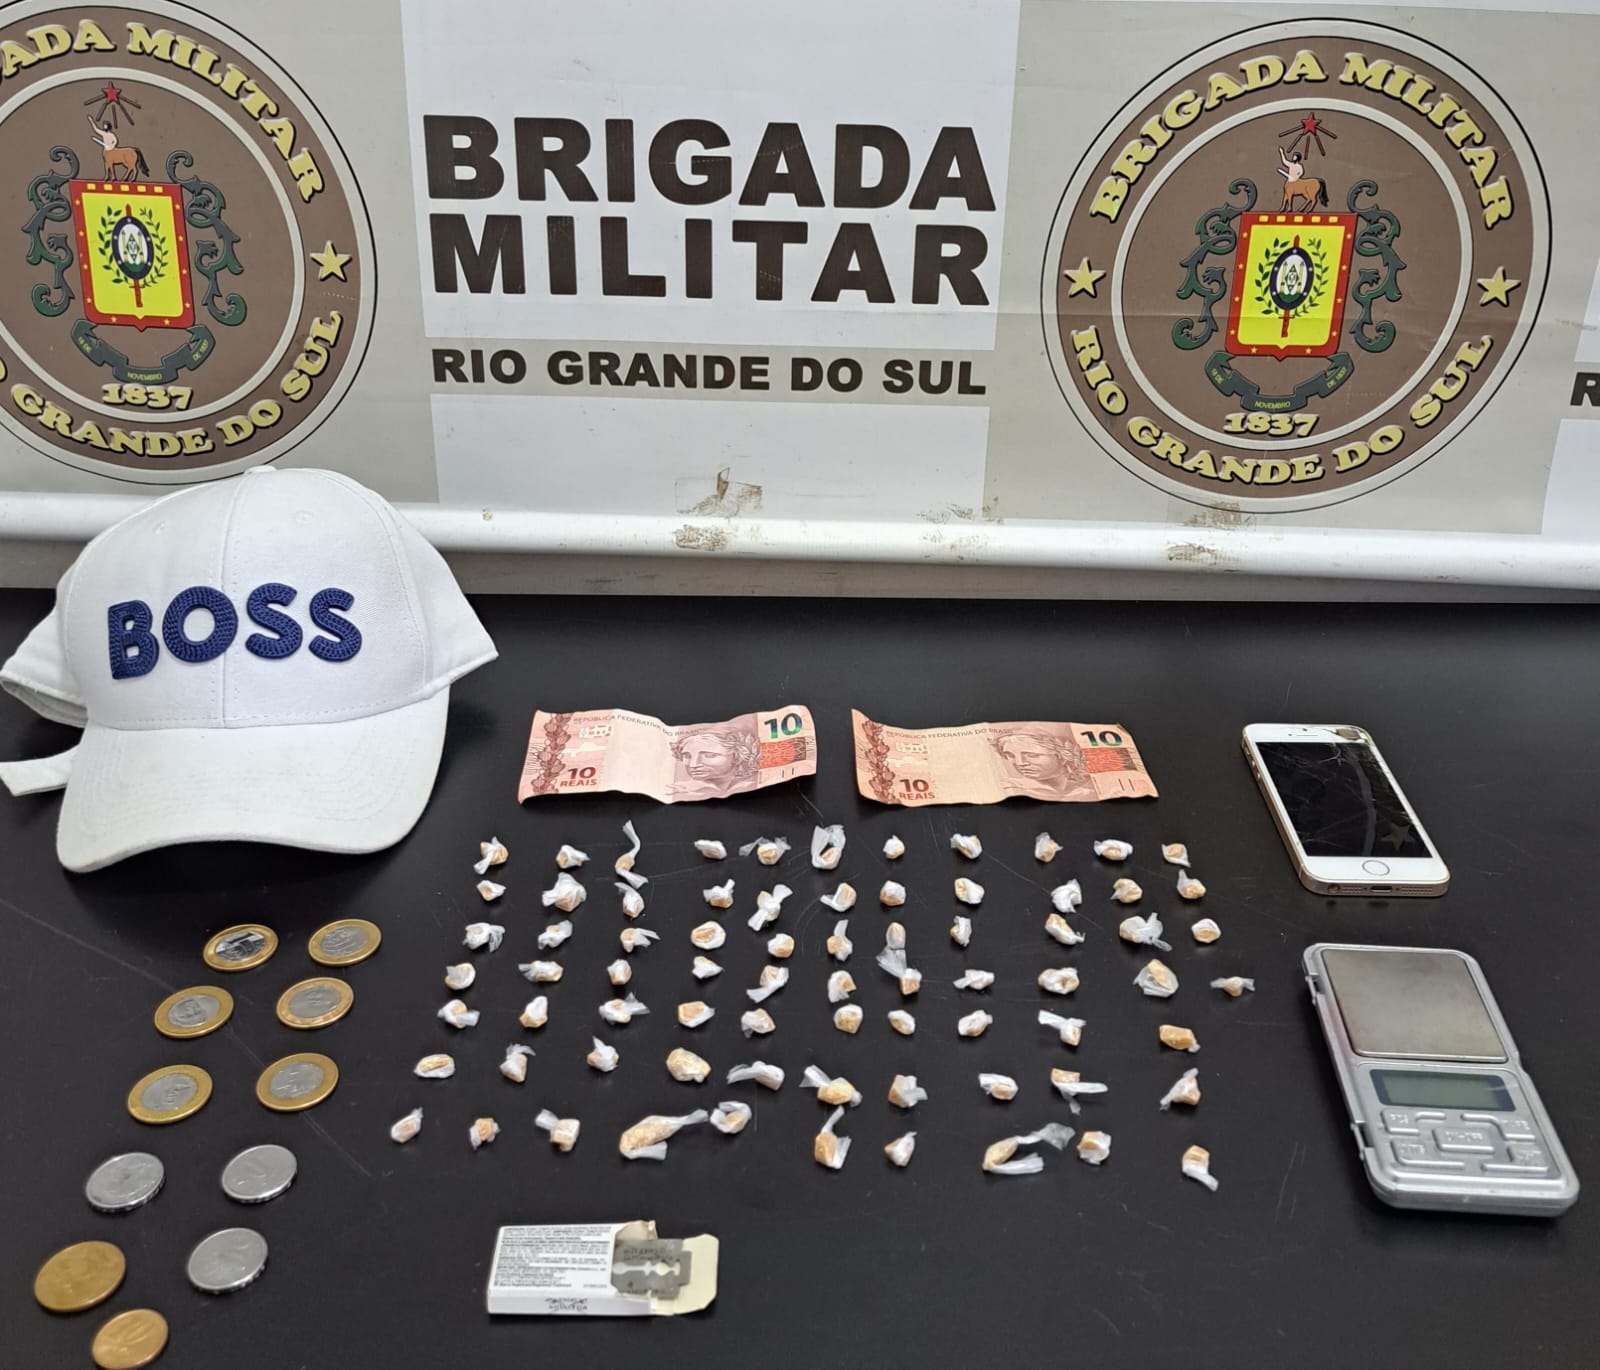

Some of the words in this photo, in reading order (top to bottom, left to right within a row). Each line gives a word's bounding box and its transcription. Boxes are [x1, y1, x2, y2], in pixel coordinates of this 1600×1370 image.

[0, 19, 116, 79] ADA
[127, 22, 326, 203] MILITAR
[1090, 49, 1328, 223] BRIGADA
[1339, 53, 1514, 230] MILITAR
[423, 114, 997, 212] BRIGADA
[429, 212, 990, 306] MILITAR
[11, 383, 215, 458] GRANDE
[217, 399, 283, 447] DO
[280, 310, 343, 403] SUL
[431, 347, 528, 385] RIO
[546, 349, 771, 390] GRANDE
[790, 356, 864, 392] DO
[882, 358, 988, 395] SUL
[102, 382, 193, 410] 1837
[1071, 325, 1129, 417] RIO
[1127, 415, 1326, 485] GRANDE
[1335, 424, 1405, 474] DO
[1409, 334, 1495, 428] SUL
[1254, 401, 1291, 409] NOVEMBRO
[1223, 411, 1320, 438] 1837
[107, 582, 363, 680] BOSS
[763, 712, 803, 739] 10
[1080, 730, 1122, 747] 10
[560, 778, 597, 788] REAIS
[567, 766, 597, 780] 10
[901, 778, 929, 793] 10
[899, 791, 935, 800] REAIS
